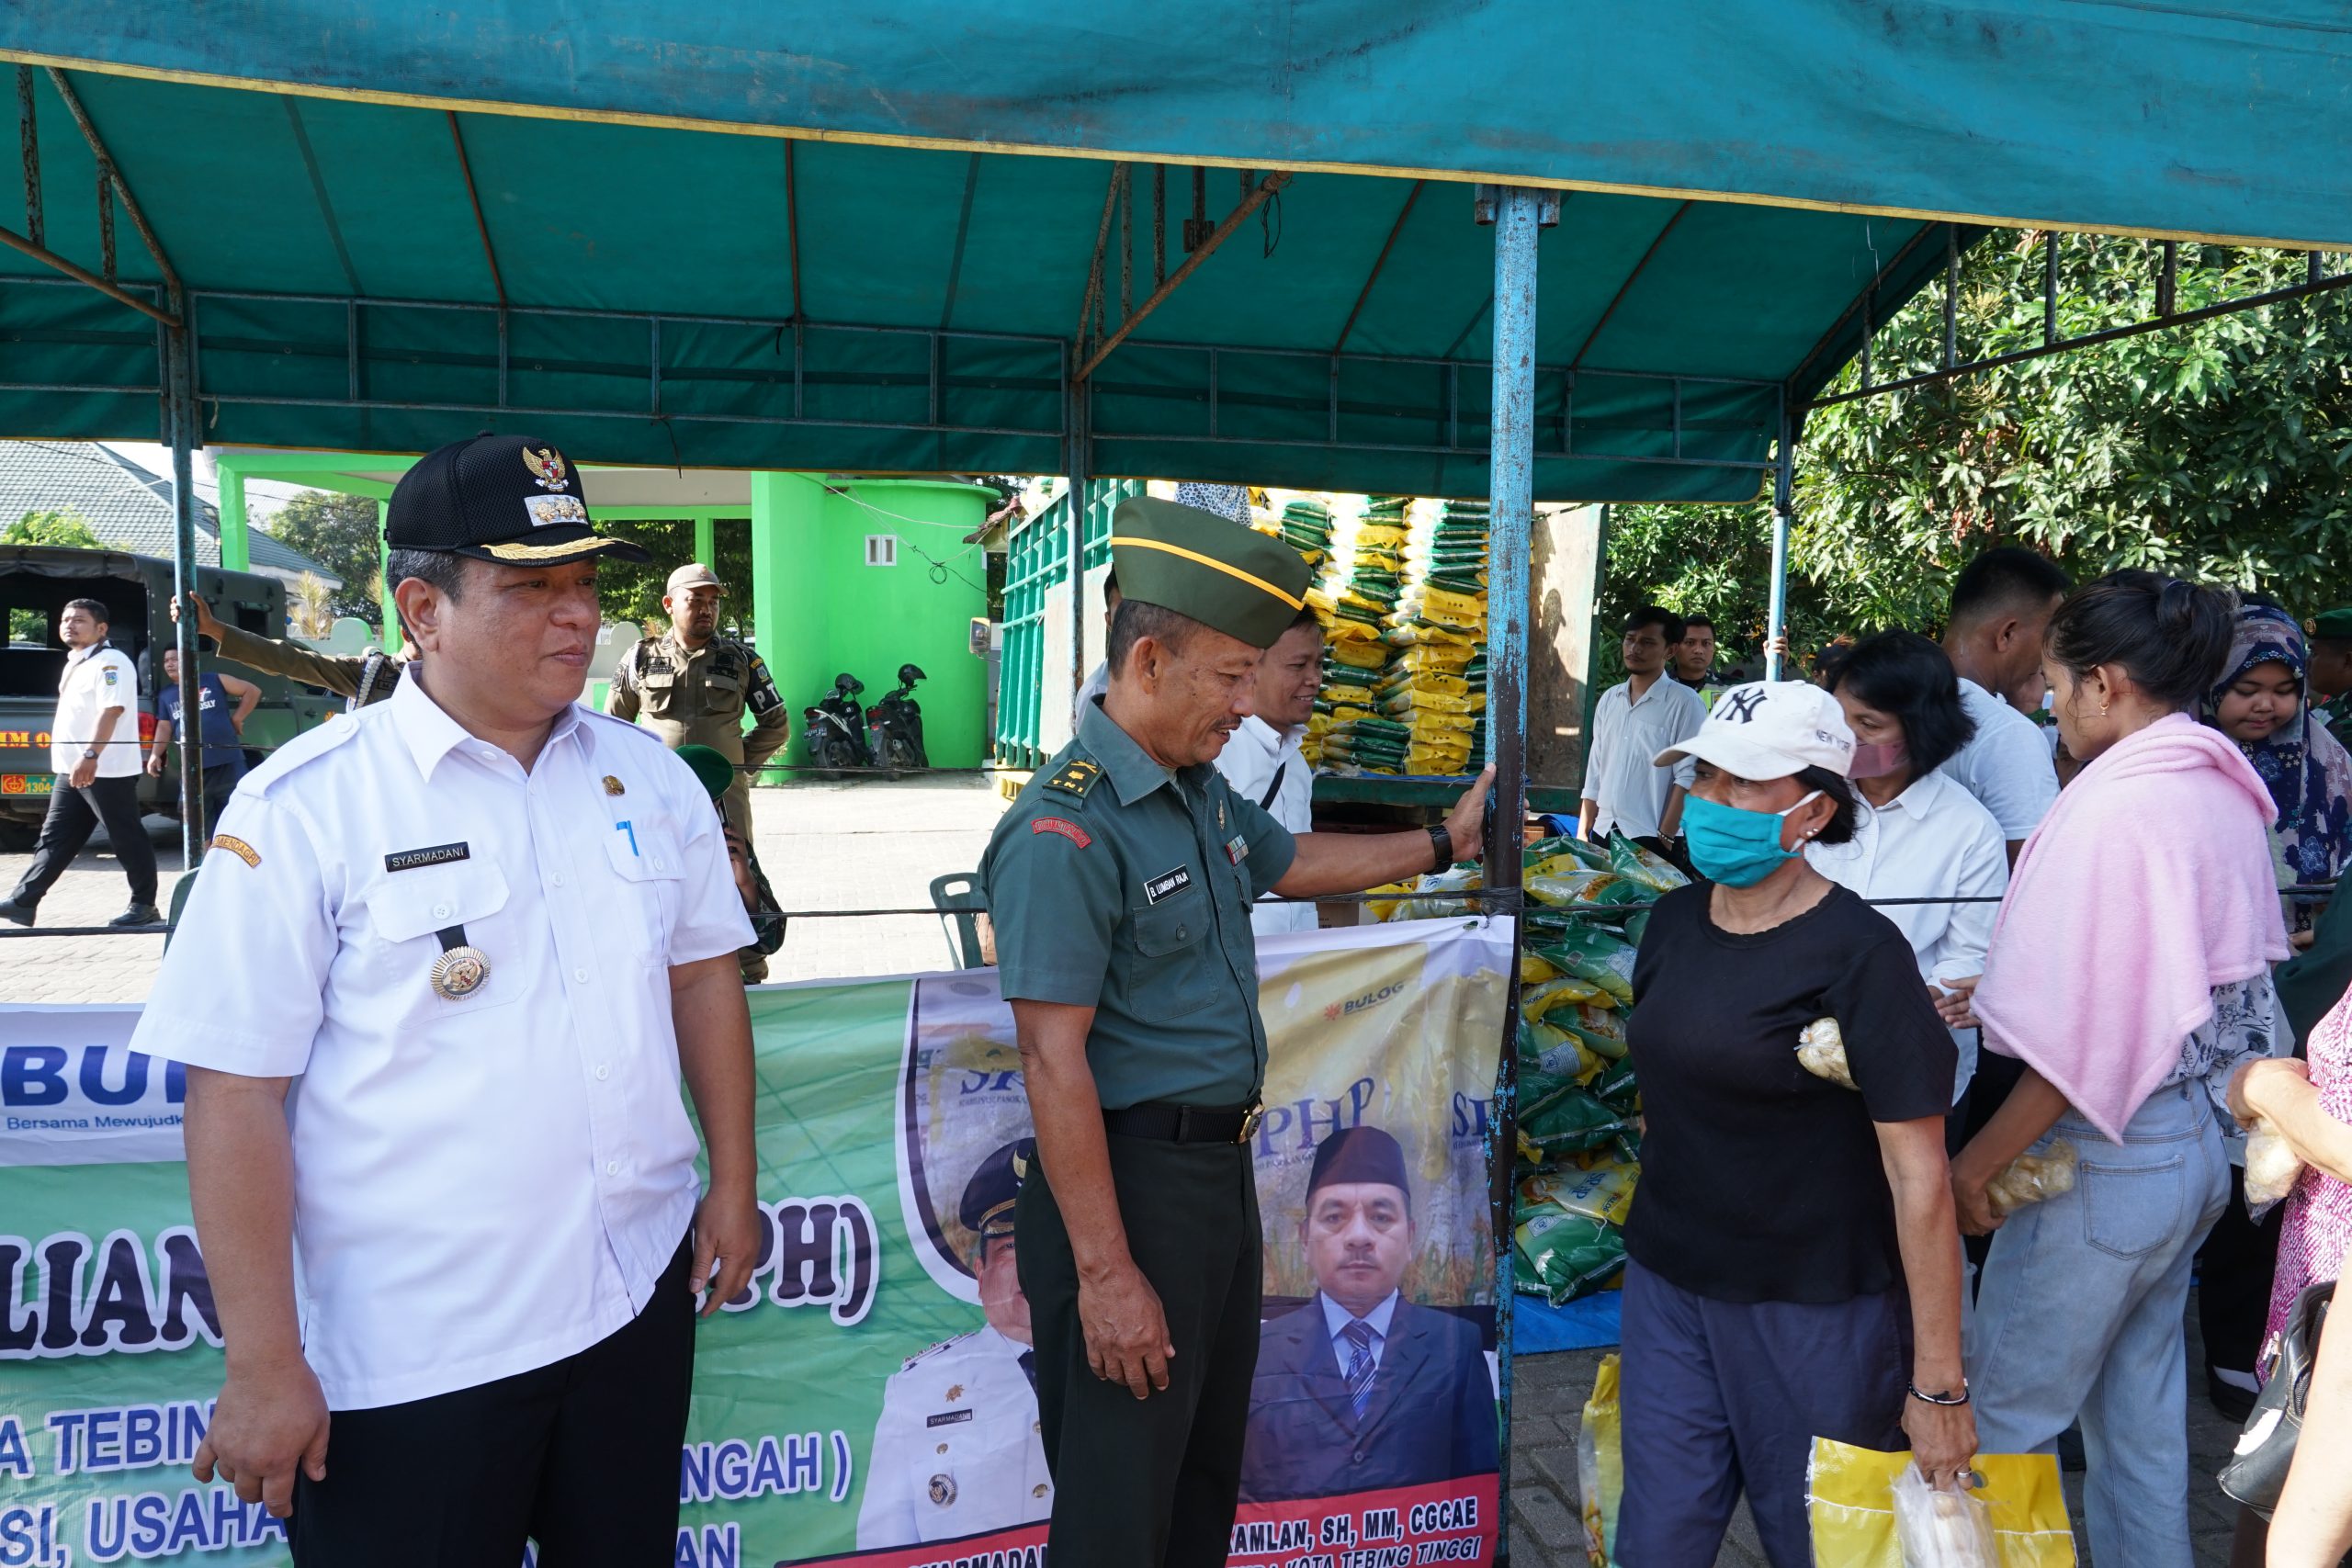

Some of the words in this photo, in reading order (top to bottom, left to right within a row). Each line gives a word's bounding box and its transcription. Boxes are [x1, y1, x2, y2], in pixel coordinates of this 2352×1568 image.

[1715, 687, 1768, 724] NY
[391, 846, 464, 868] SYARMADANI
[1156, 877, 1175, 895] LUMBAN
[1175, 872, 1189, 886] RAJA
[1344, 981, 1405, 1013] BULOG
[7, 1116, 89, 1131] Bersama
[1323, 1516, 1356, 1548] SH,
[1365, 1510, 1402, 1541] MM,
[1410, 1497, 1477, 1536] CGCAE
[1418, 1537, 1480, 1563] TINGGI
